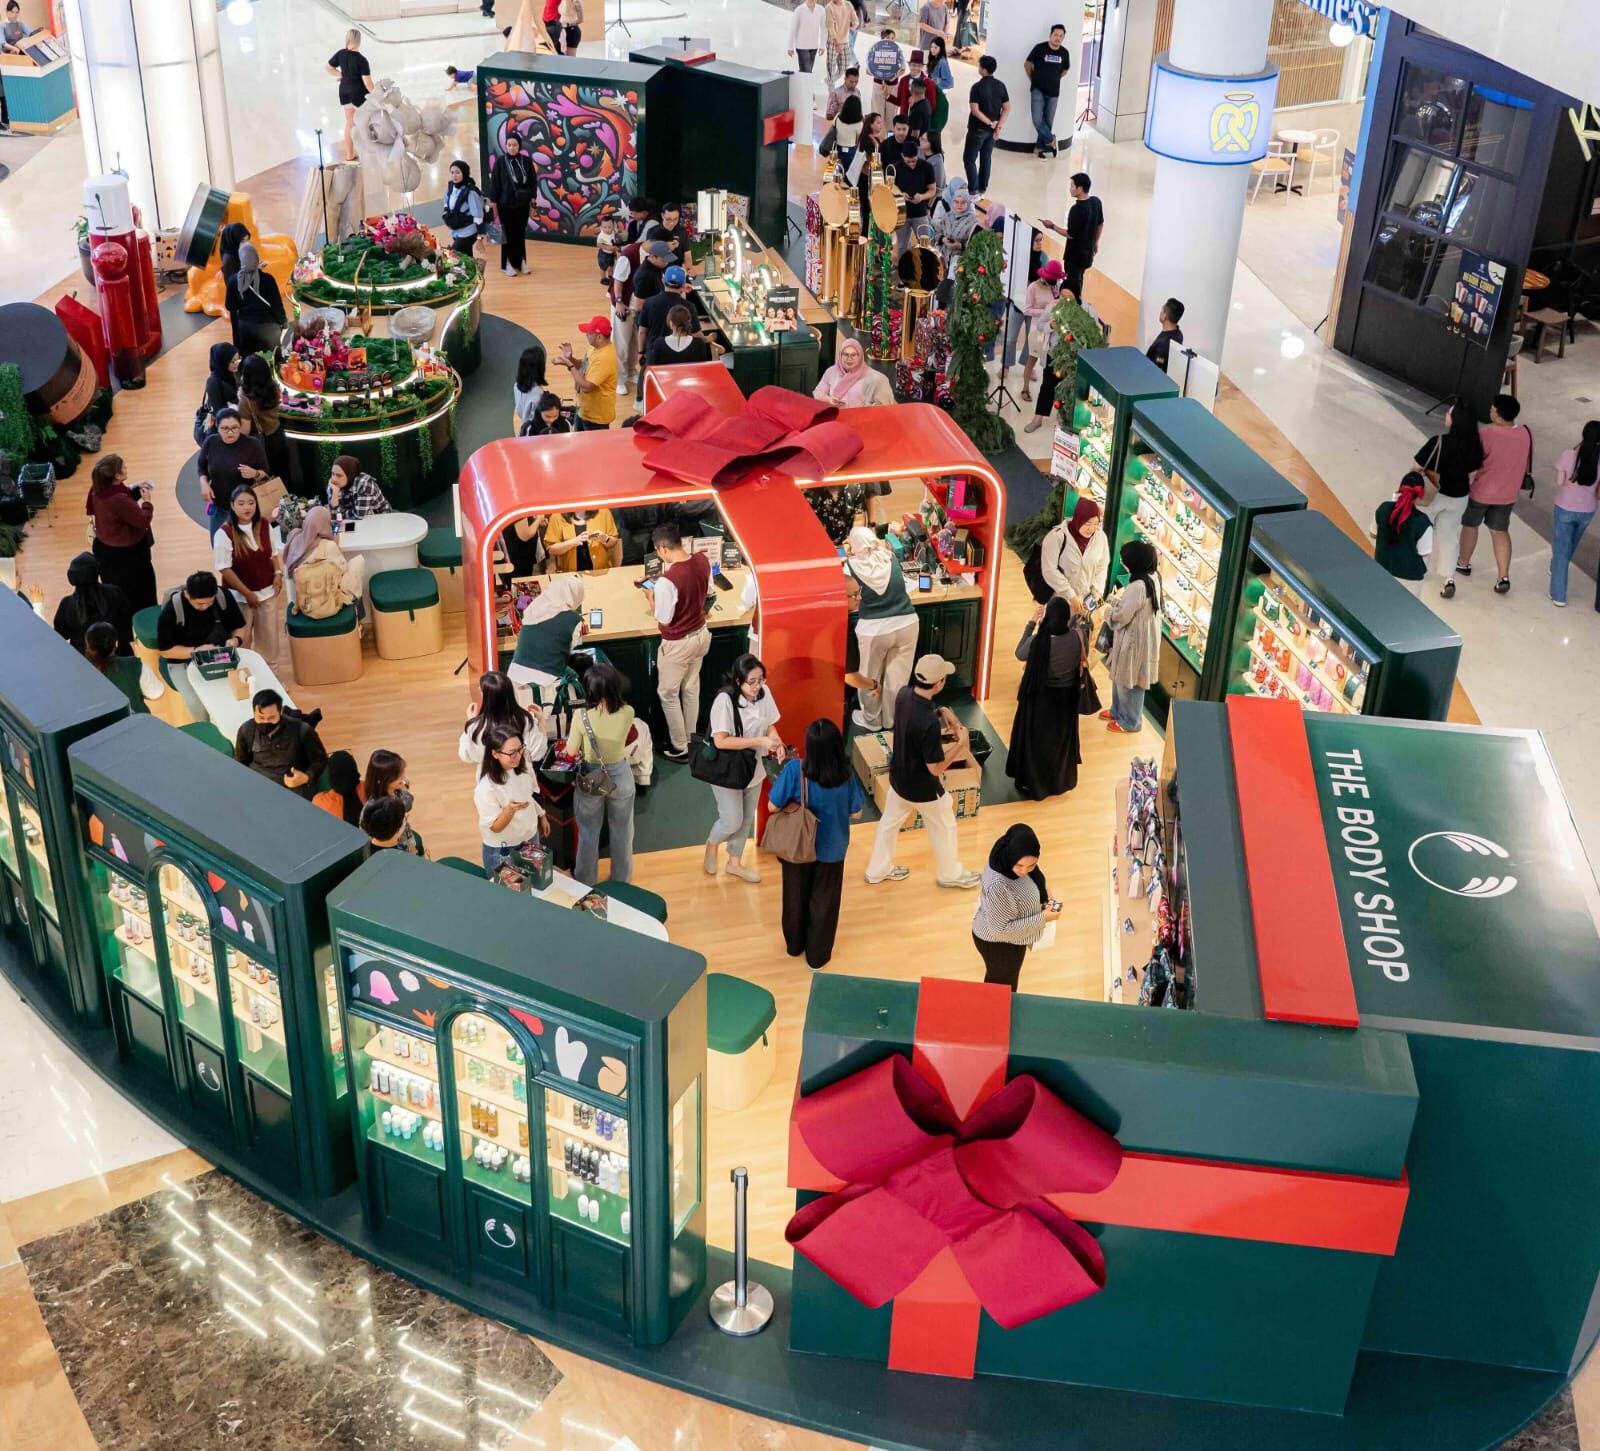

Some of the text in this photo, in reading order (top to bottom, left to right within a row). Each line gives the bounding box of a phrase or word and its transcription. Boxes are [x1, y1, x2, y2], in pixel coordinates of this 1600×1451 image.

[1325, 749, 1411, 983] THE BODY SHOP
